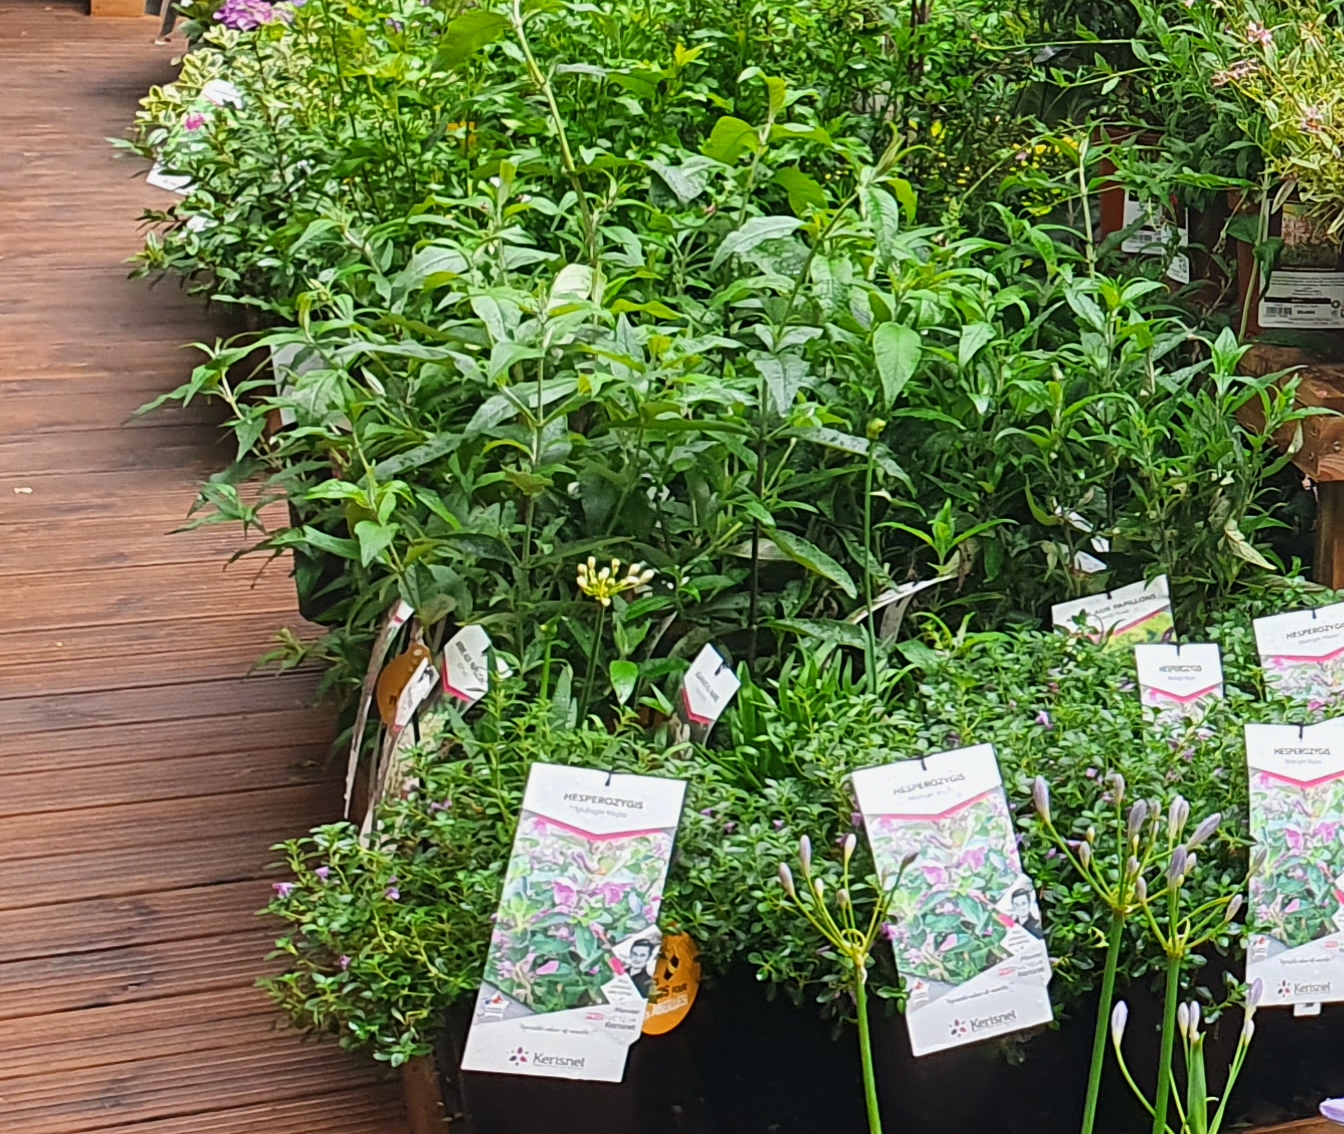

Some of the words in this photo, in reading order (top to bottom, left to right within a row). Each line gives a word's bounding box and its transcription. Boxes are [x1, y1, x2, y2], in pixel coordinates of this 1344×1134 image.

[1113, 593, 1157, 609] PAPILLONS
[893, 773, 966, 795] HESPEROZYGIS
[563, 792, 643, 809] HESPEROZYGIS
[1294, 981, 1331, 993] Kerisnel
[970, 1009, 1017, 1032] Kerisnel
[533, 1052, 585, 1068] Kerisnel
